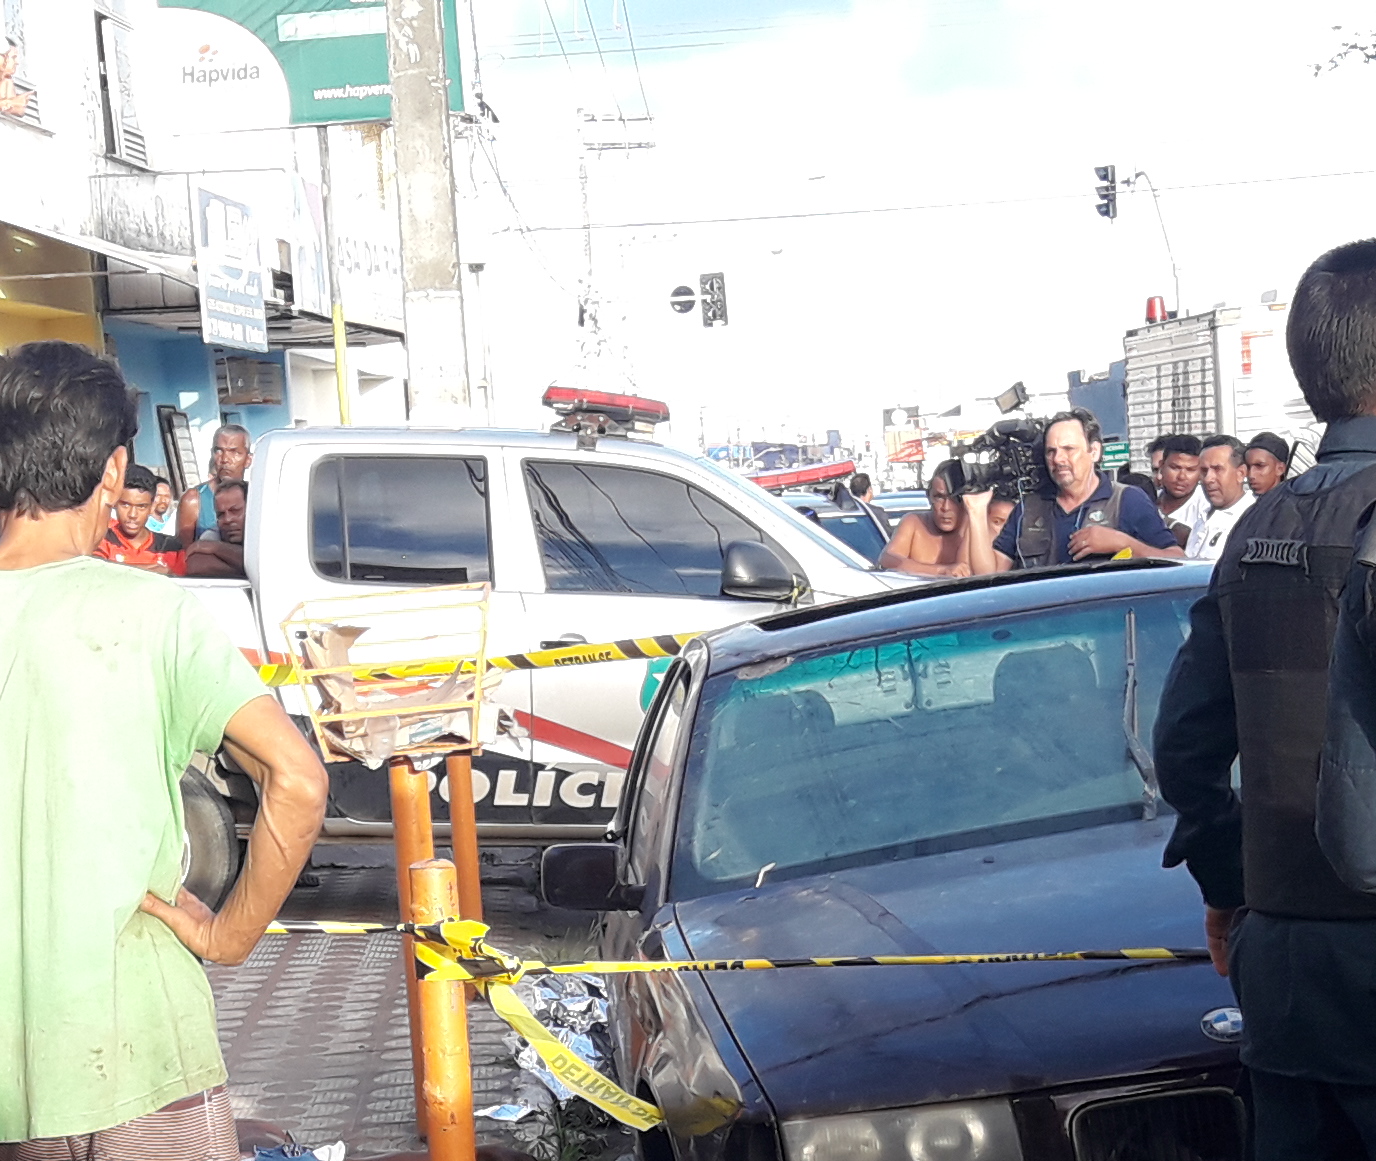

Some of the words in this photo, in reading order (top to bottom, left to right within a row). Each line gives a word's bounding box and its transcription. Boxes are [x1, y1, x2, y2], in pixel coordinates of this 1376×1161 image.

[182, 63, 260, 87] Hapvida
[553, 651, 613, 667] DETRANSE
[425, 762, 624, 809] OLÍCI
